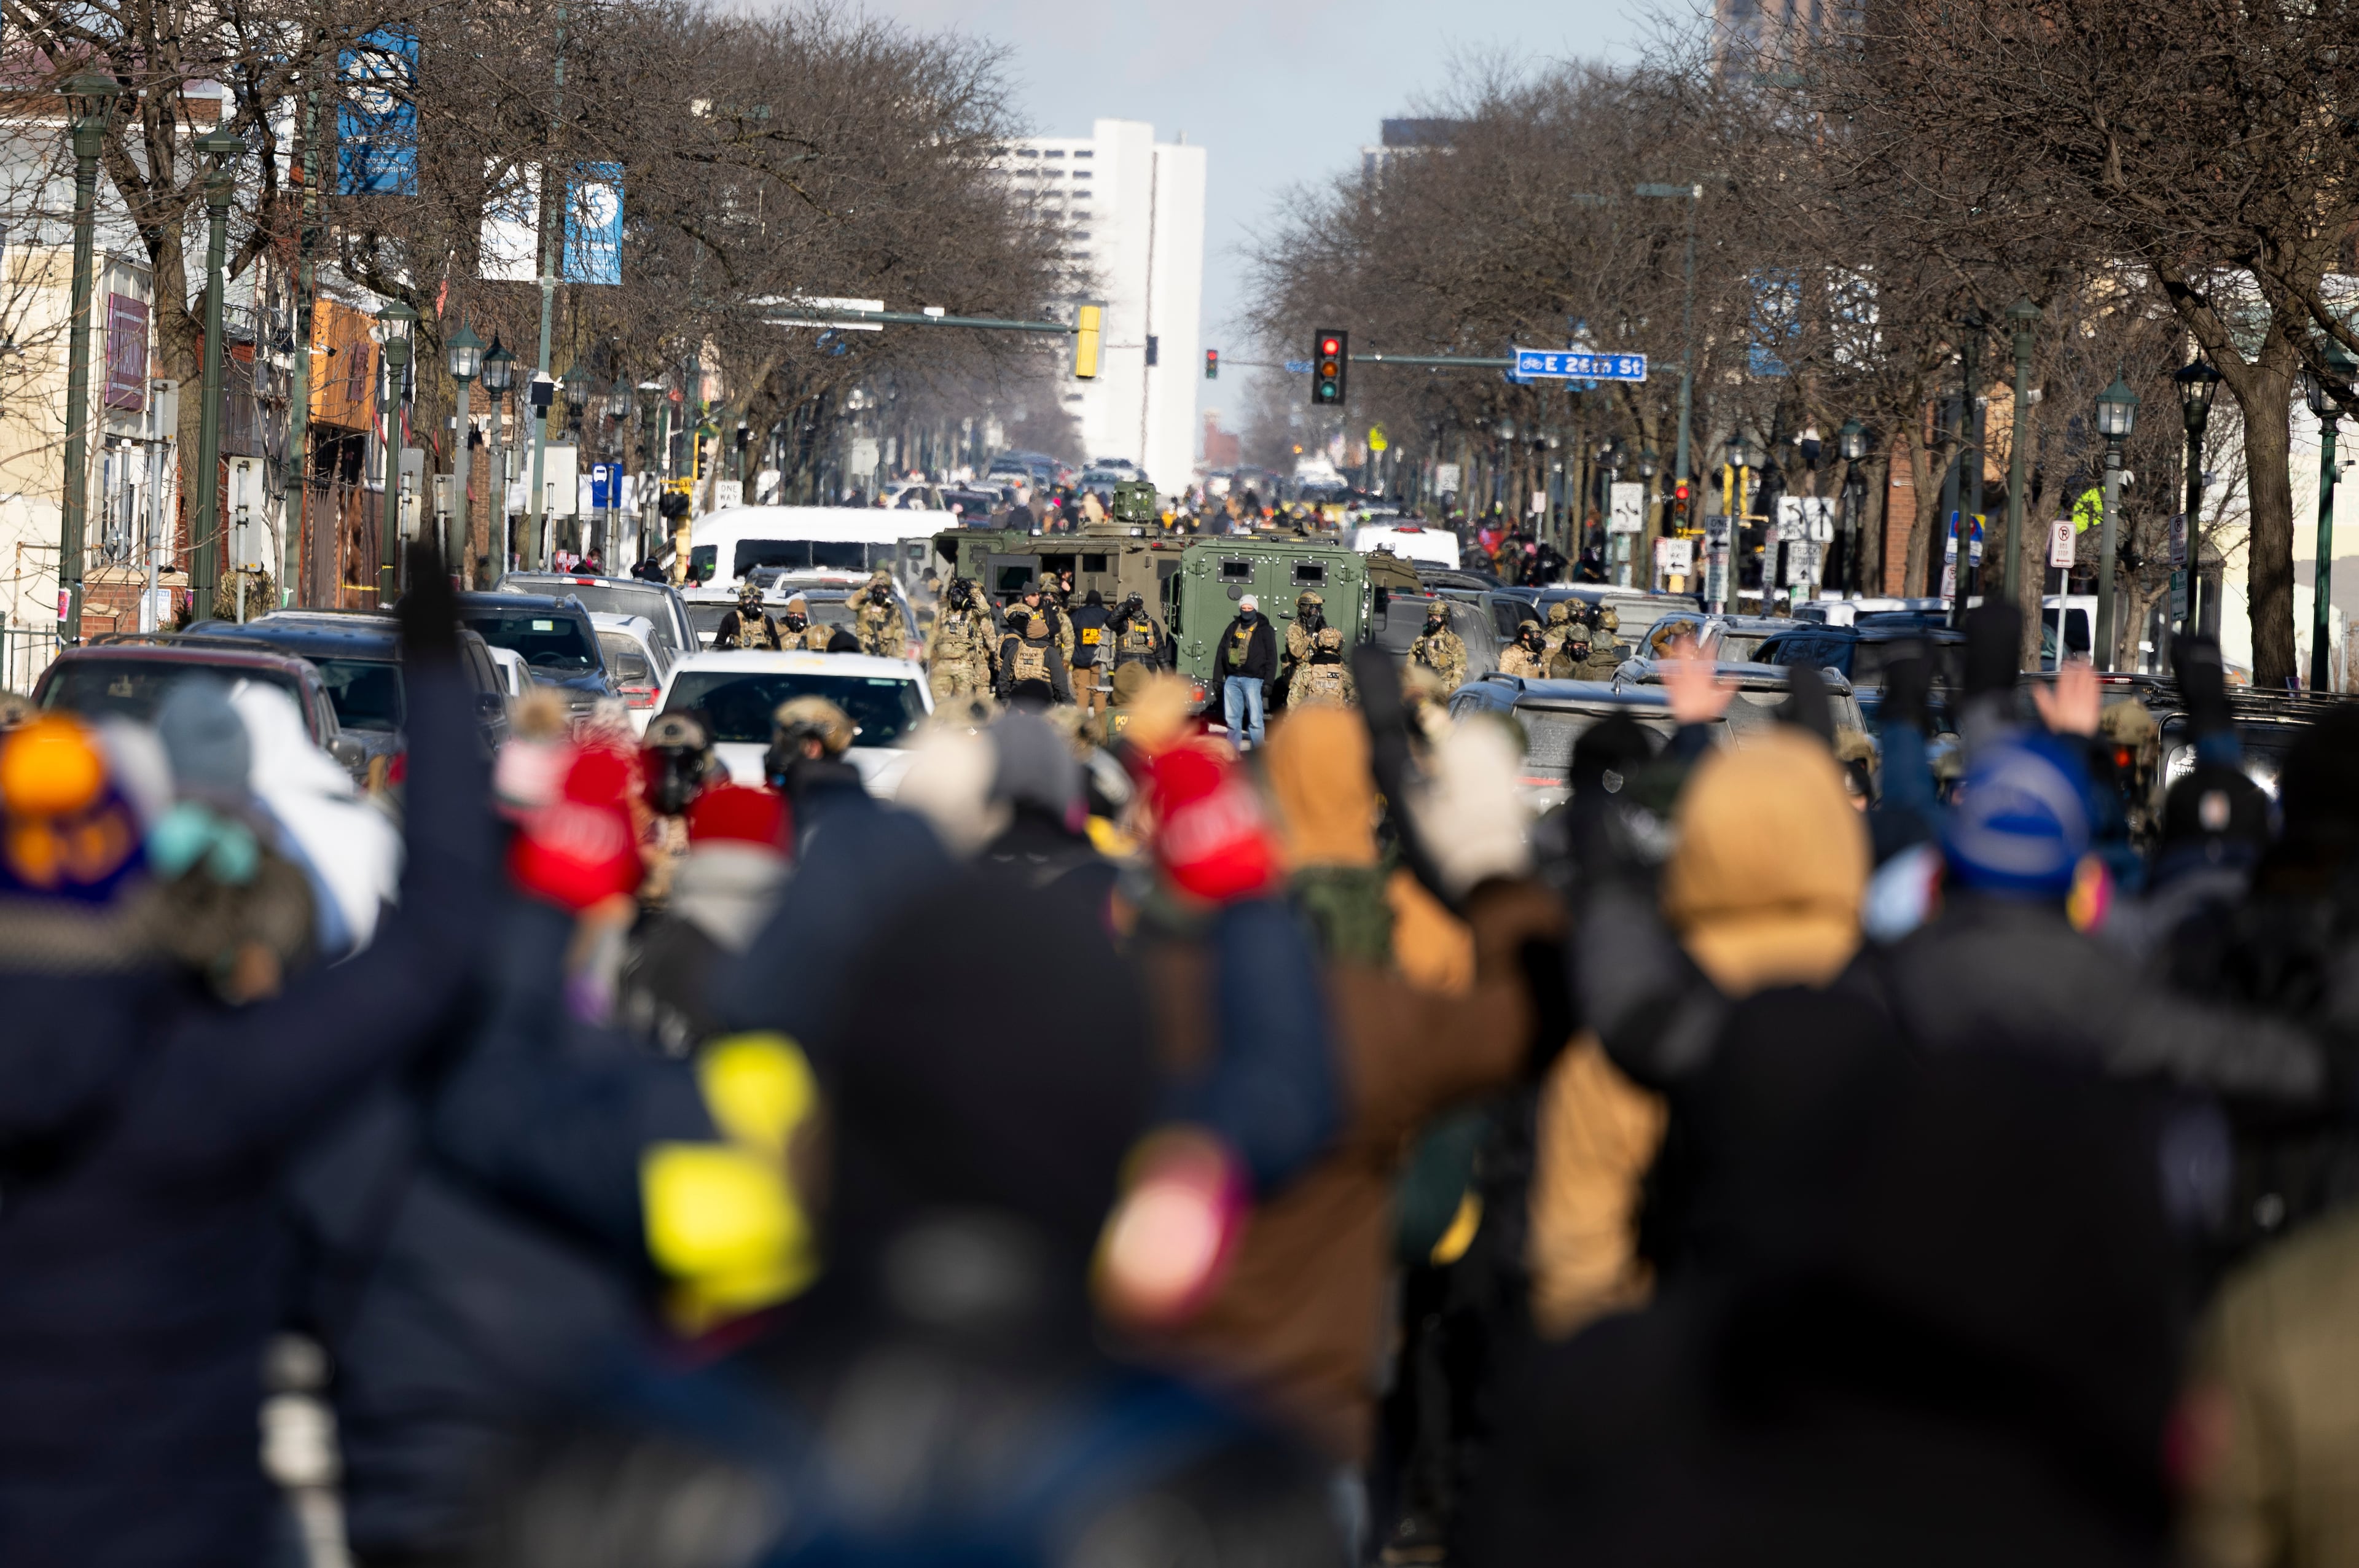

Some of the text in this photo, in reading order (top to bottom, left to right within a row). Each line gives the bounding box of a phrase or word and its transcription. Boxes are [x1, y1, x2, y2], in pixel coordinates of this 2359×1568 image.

[1544, 356, 1558, 372] E
[1618, 358, 1641, 375] St
[1710, 519, 1730, 528] ONE
[1791, 557, 1818, 566] ROUTE
